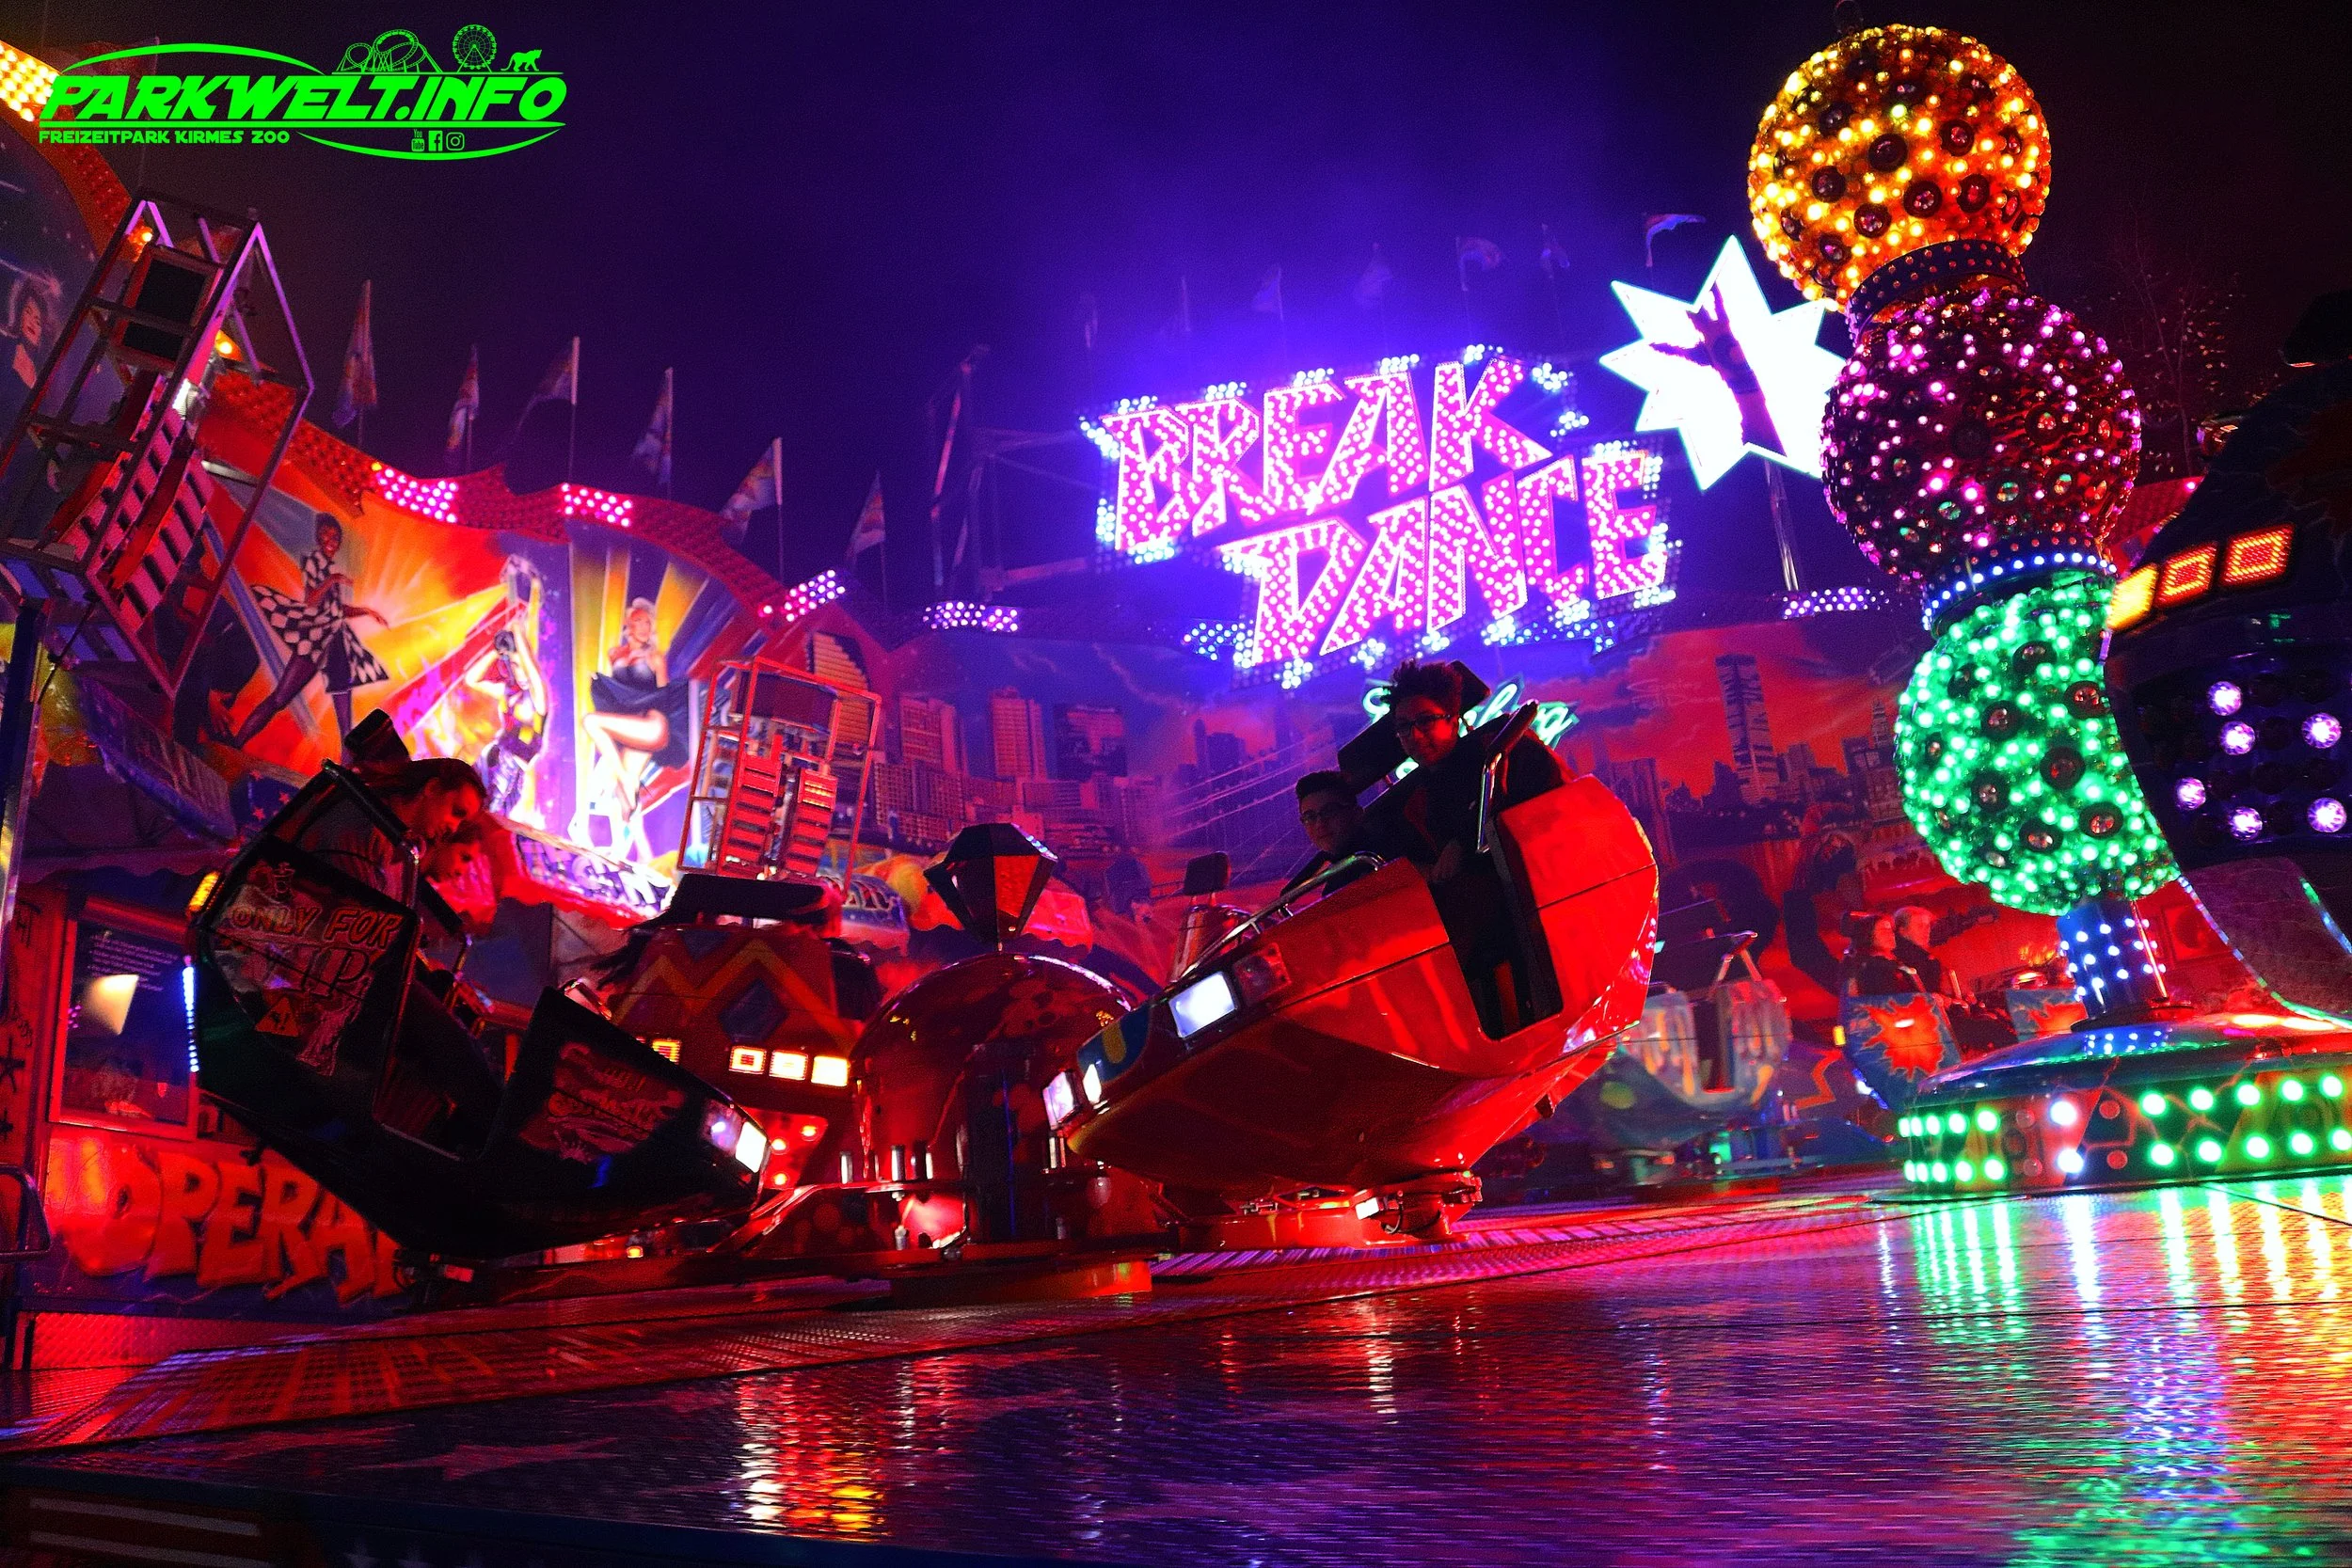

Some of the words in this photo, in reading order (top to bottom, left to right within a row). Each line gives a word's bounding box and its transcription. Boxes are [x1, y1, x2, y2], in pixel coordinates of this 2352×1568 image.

[1099, 356, 1552, 551] BREAK
[1216, 450, 1667, 666] DANCE
[324, 908, 405, 951] FOR
